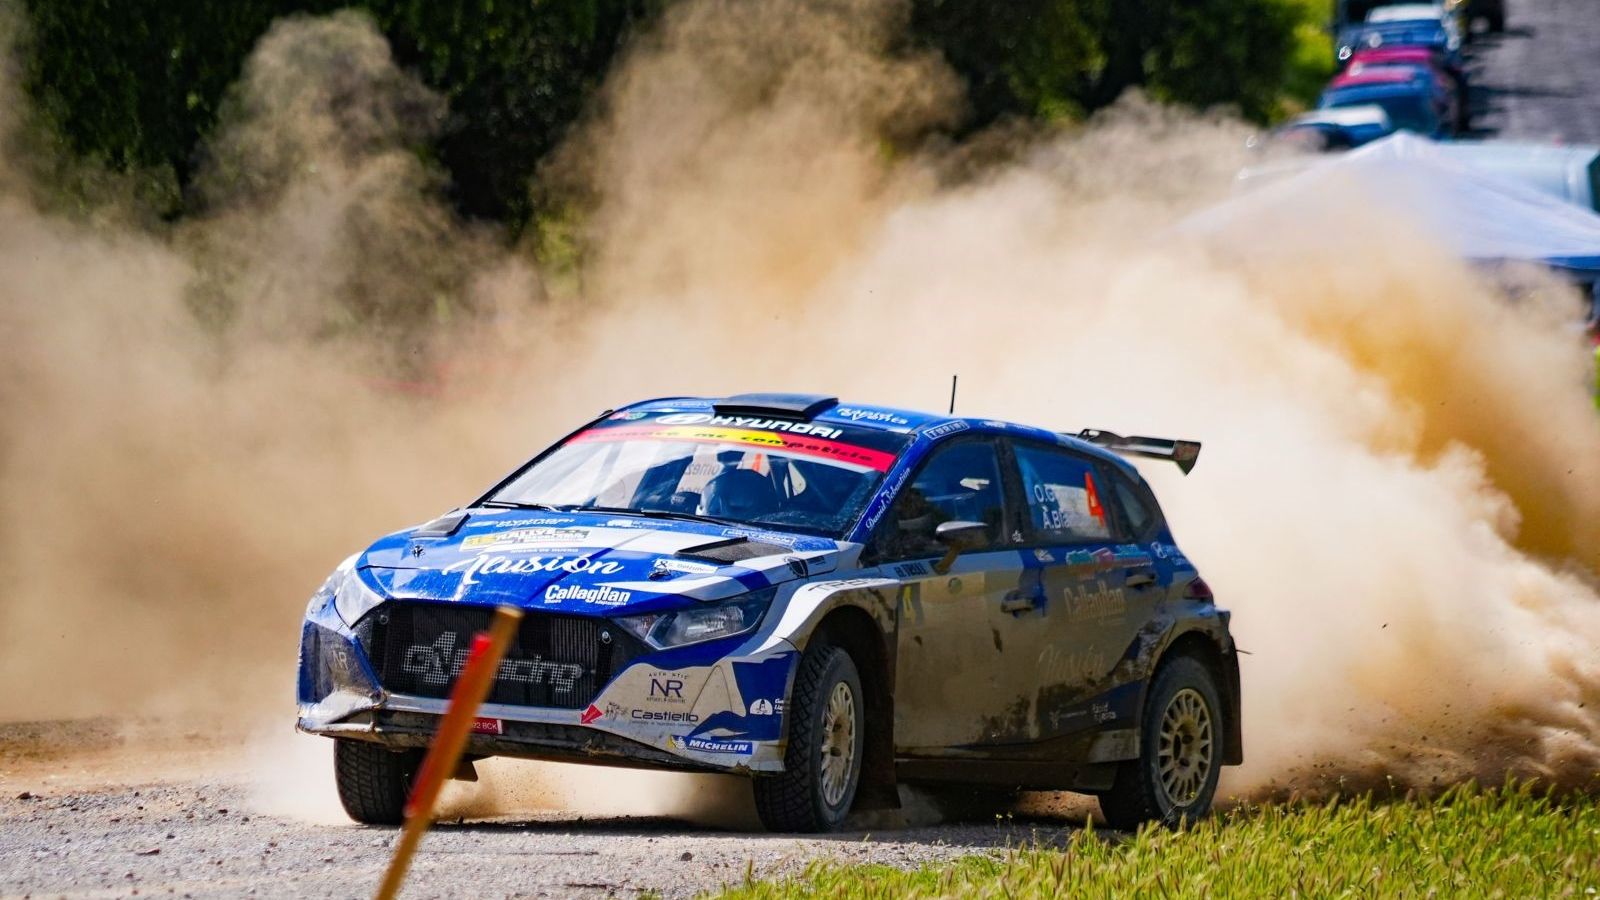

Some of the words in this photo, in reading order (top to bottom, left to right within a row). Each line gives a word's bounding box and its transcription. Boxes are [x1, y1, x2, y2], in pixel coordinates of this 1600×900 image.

[711, 416, 844, 439] HYUNDAI
[650, 679, 684, 698] NR
[689, 739, 749, 752] MICHELIN
